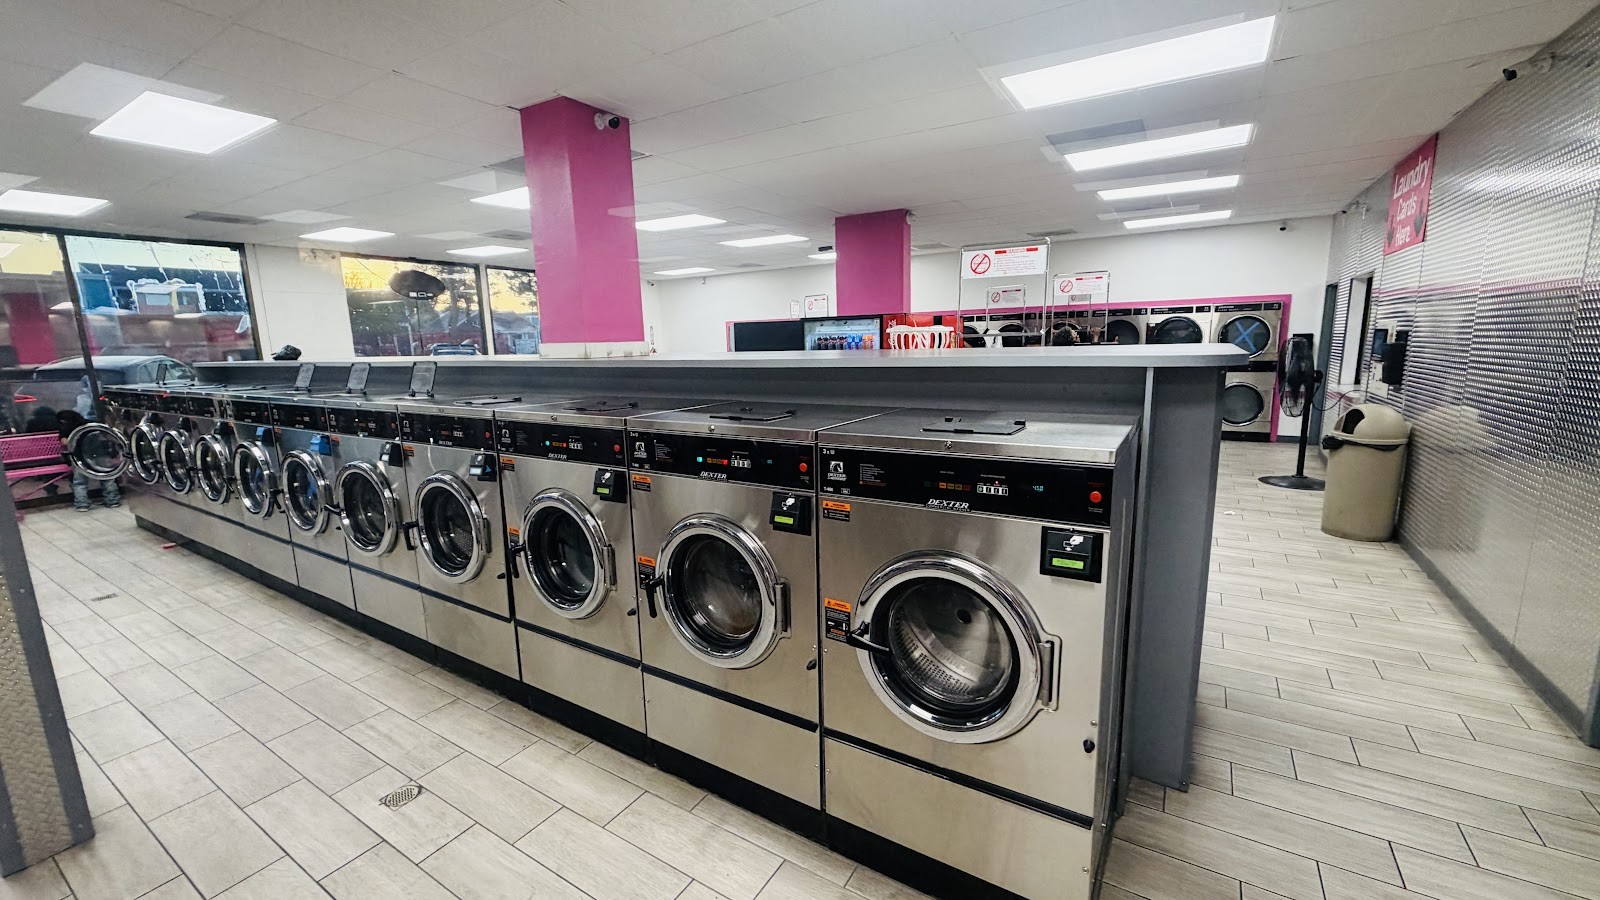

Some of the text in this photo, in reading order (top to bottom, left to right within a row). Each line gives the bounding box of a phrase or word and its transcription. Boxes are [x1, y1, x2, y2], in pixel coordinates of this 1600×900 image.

[1393, 156, 1431, 199] Laundry
[1396, 191, 1417, 221] Cards
[1395, 224, 1411, 247] Here
[699, 471, 728, 480] DEXTER
[927, 498, 970, 509] DEXTER
